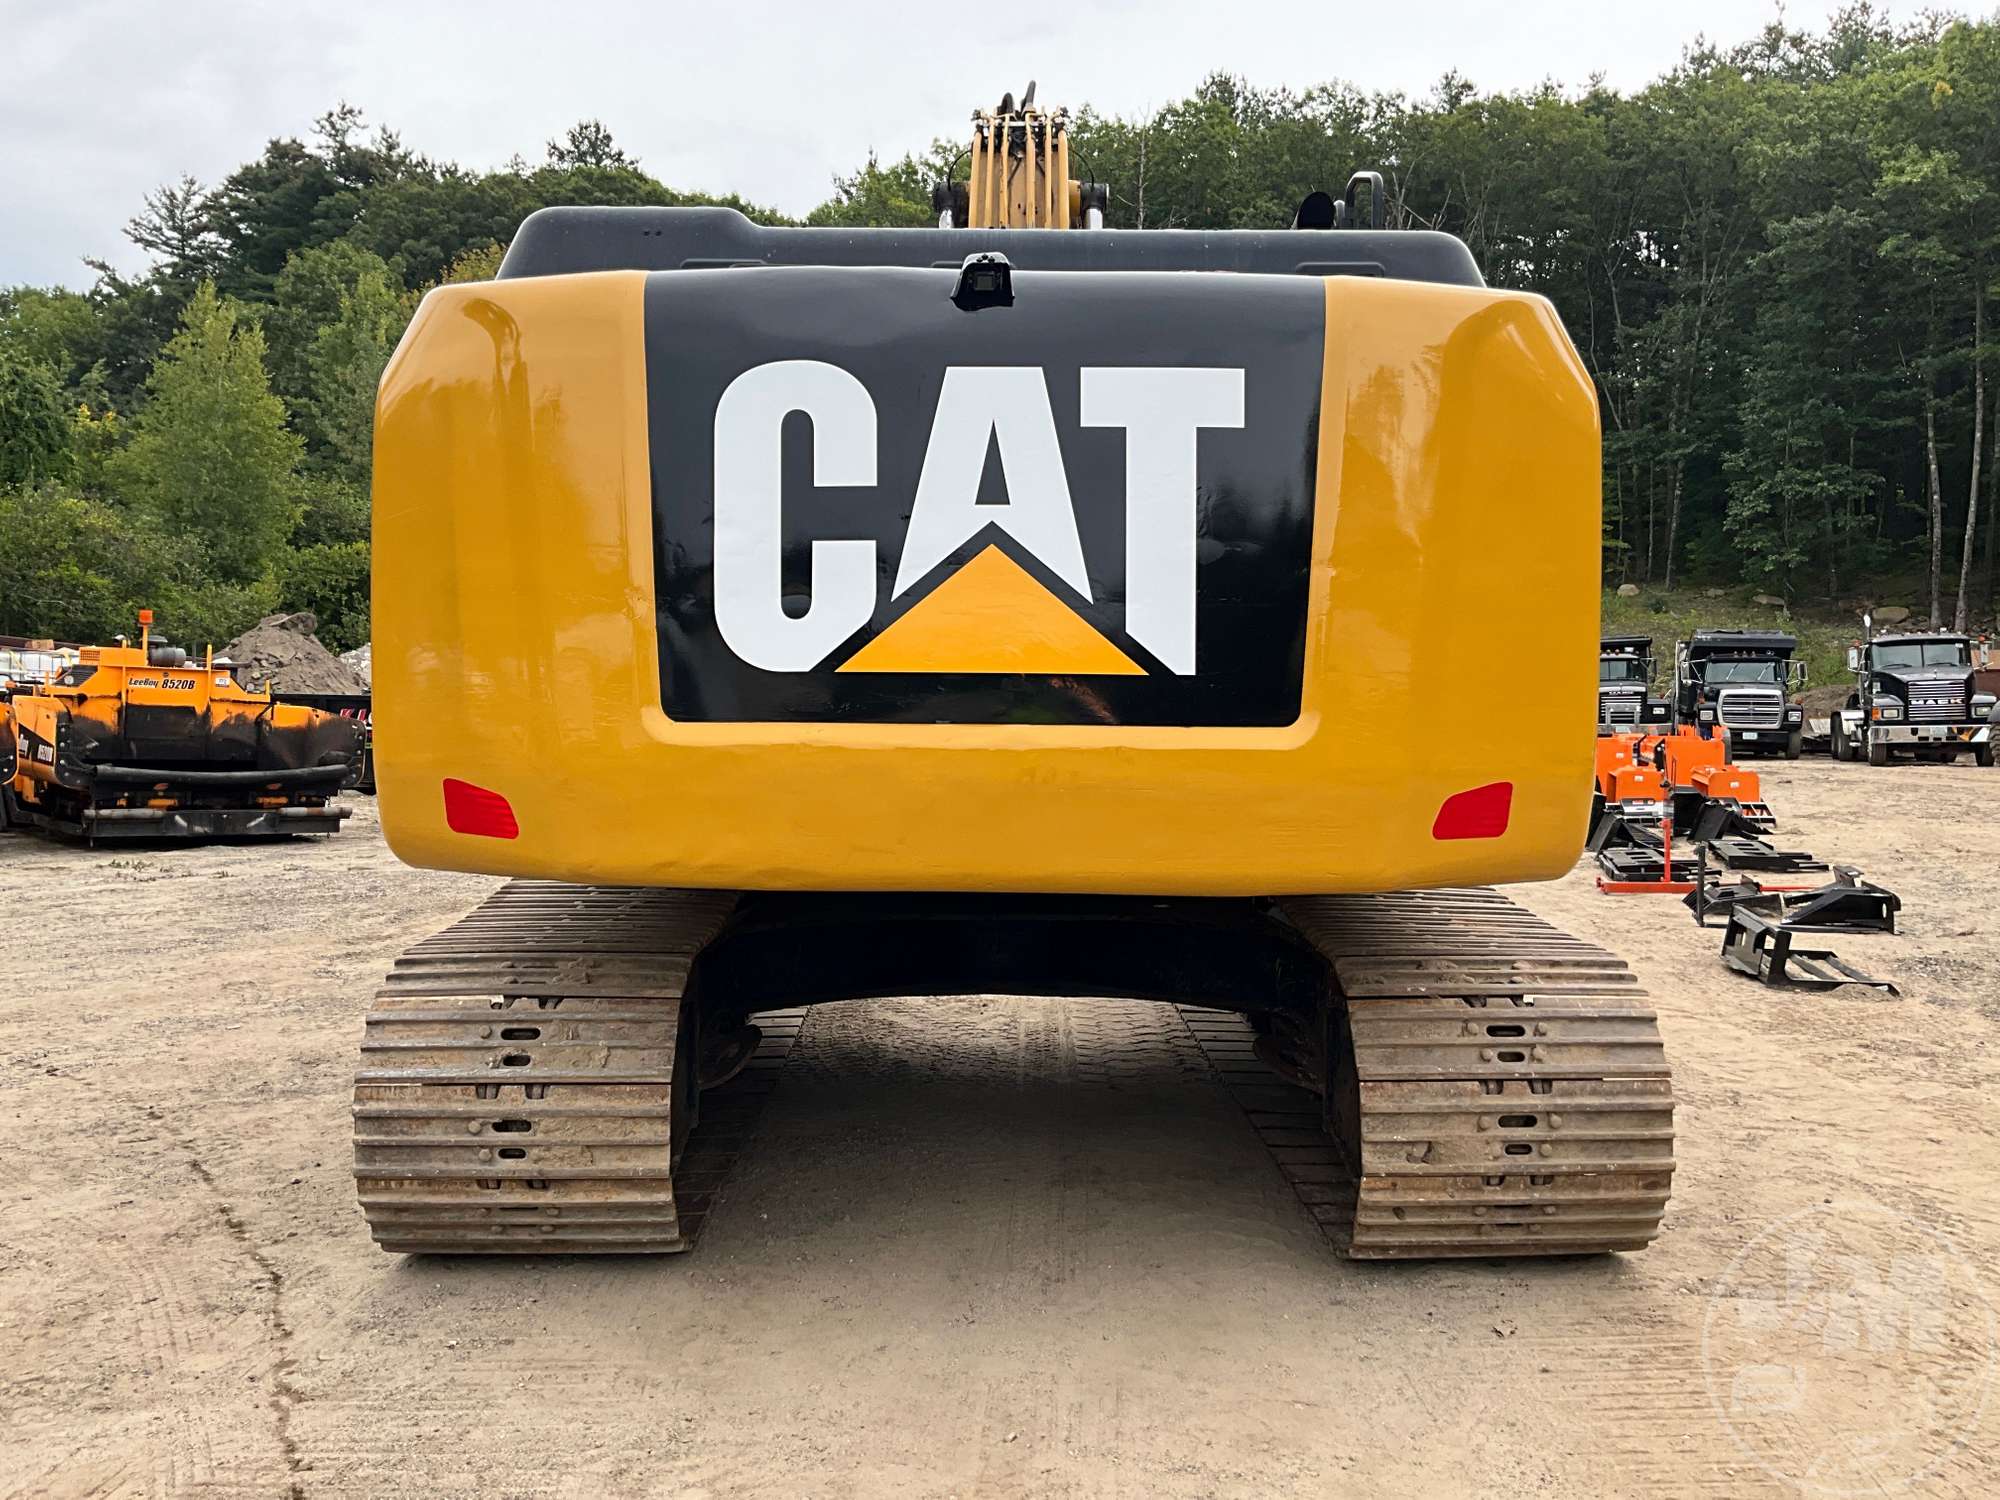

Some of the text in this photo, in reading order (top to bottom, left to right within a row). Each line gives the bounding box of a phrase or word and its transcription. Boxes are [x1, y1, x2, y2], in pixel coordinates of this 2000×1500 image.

[713, 359, 1245, 676] CAT
[128, 678, 196, 690] LeeBoy 8520B
[1910, 698, 1963, 706] MACK
